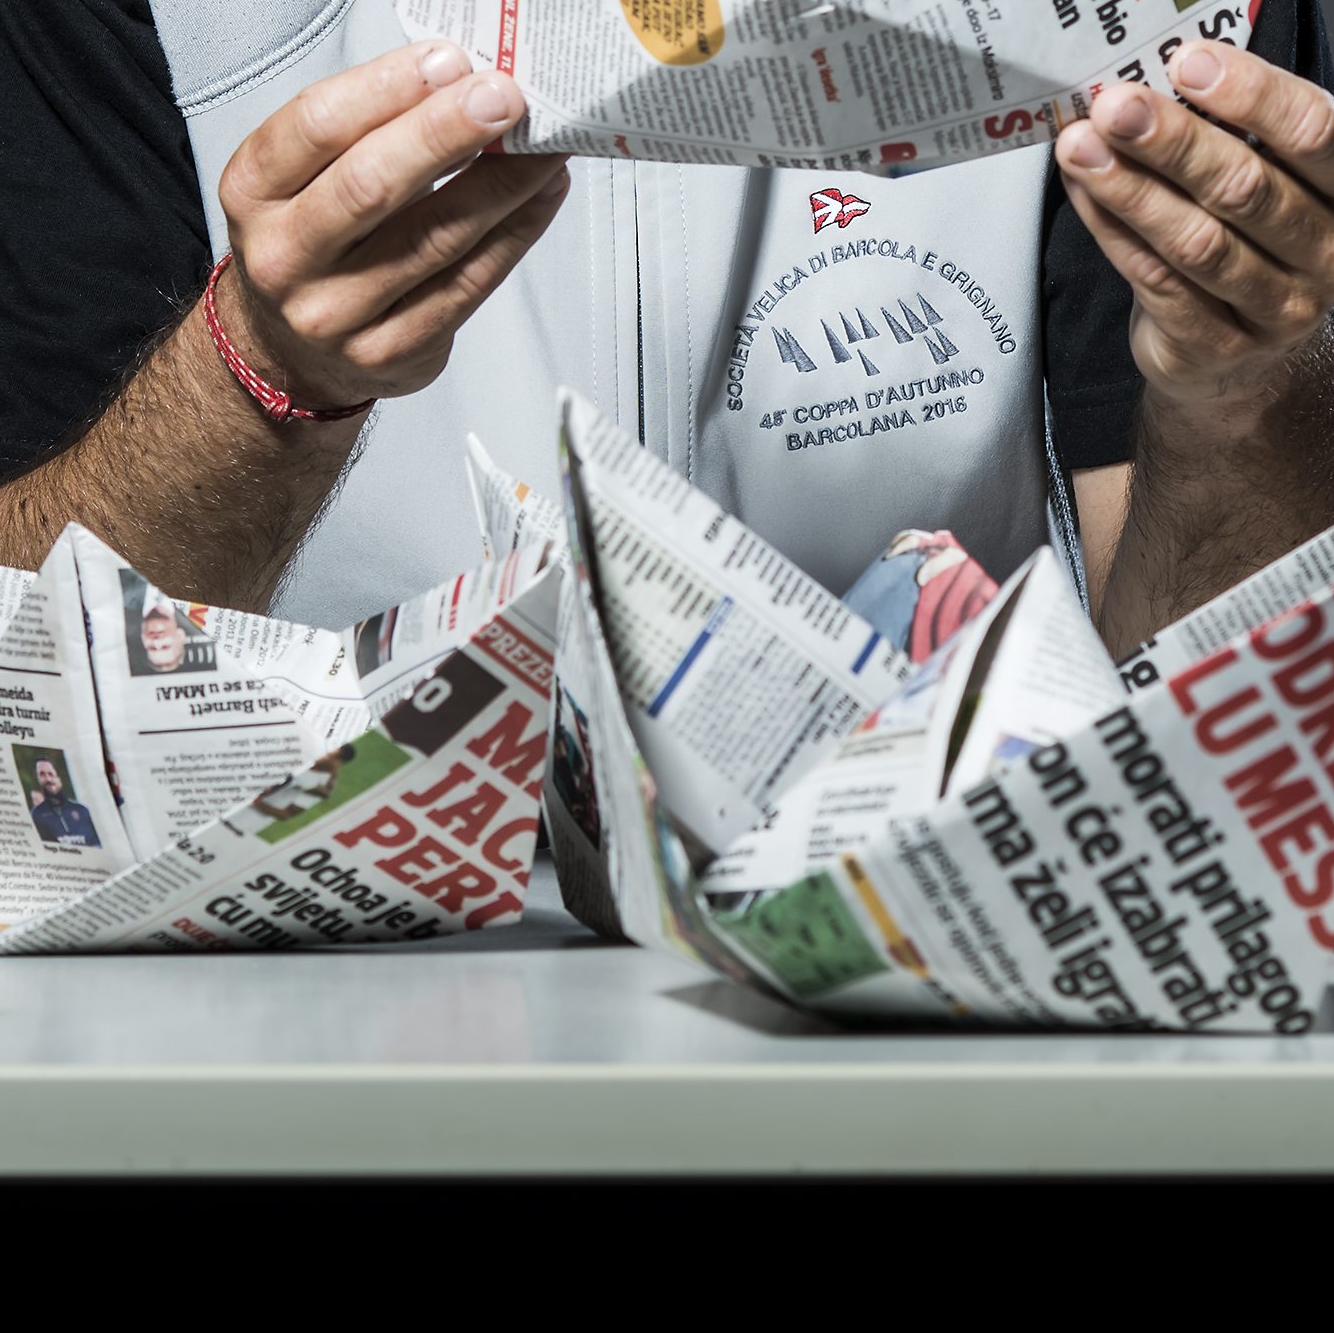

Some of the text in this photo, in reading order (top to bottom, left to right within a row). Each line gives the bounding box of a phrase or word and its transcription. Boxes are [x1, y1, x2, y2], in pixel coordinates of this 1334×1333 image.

[747, 267, 809, 321] VELICA
[808, 251, 828, 273] DI
[831, 238, 918, 263] BARCOLA
[921, 251, 939, 271] E
[939, 261, 1017, 355] GRIGNANO
[785, 396, 967, 451] BARCOLANA 2016
[793, 398, 859, 425] COPPA
[865, 368, 985, 409] D'AUTUNNO
[15, 706, 49, 721] turnir
[157, 684, 205, 699] MMA!
[190, 699, 253, 716] Barnett
[208, 682, 219, 693] u
[223, 680, 241, 691] se
[1169, 652, 1275, 755] LU
[404, 749, 539, 888] JAC
[1101, 710, 1220, 861] morati
[292, 842, 386, 927] Ochoa
[365, 888, 419, 942] je
[1012, 859, 1095, 946] želi
[1027, 744, 1231, 1031] on će izabrati
